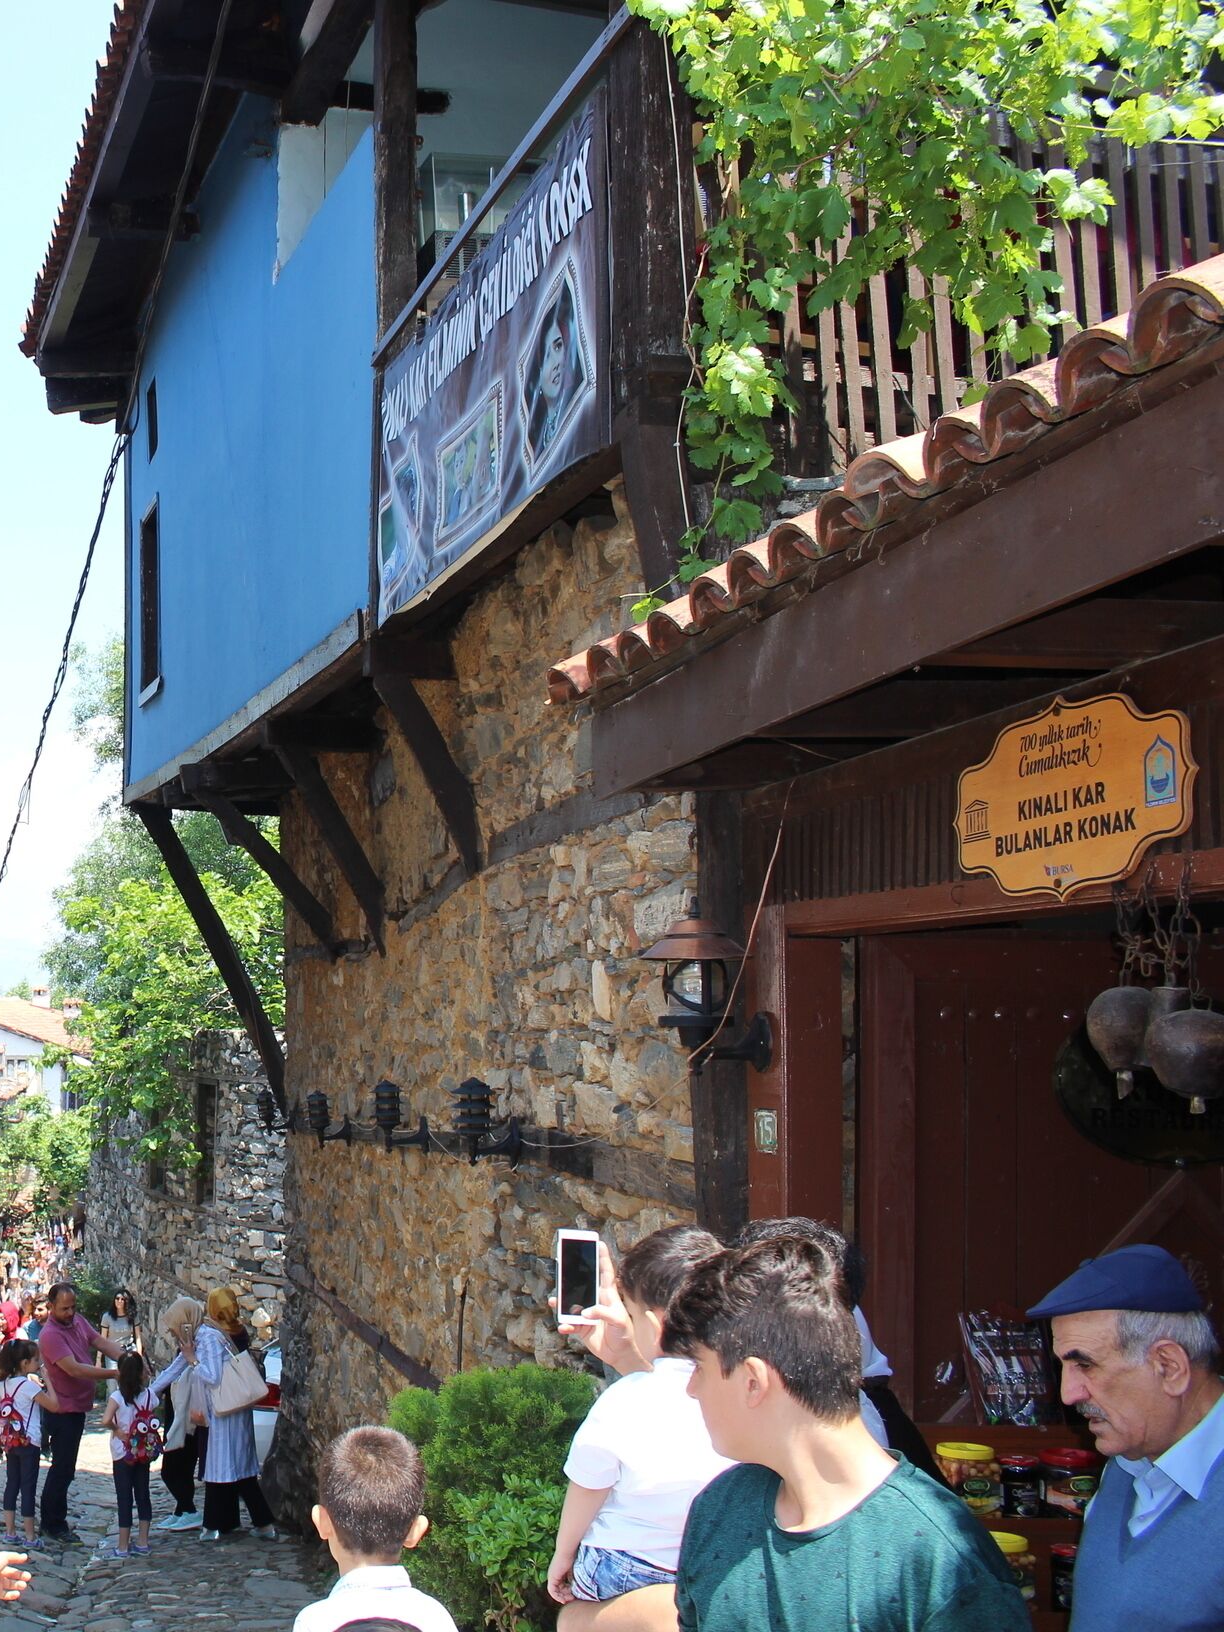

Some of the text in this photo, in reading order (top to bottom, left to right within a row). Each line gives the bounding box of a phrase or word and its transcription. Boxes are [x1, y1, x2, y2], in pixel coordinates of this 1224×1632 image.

[409, 350, 428, 422] KAR
[479, 194, 538, 361] ÇEKİLDİĞİ
[539, 137, 593, 268] KONAK
[1019, 739, 1102, 778] Cumalıkızık
[1020, 733, 1037, 753] 700
[1038, 723, 1064, 752] yıllık
[1018, 789, 1068, 822] KINALI
[1072, 781, 1106, 809] KAR
[994, 821, 1073, 857] BULANLAR
[1078, 807, 1137, 840] KONAK
